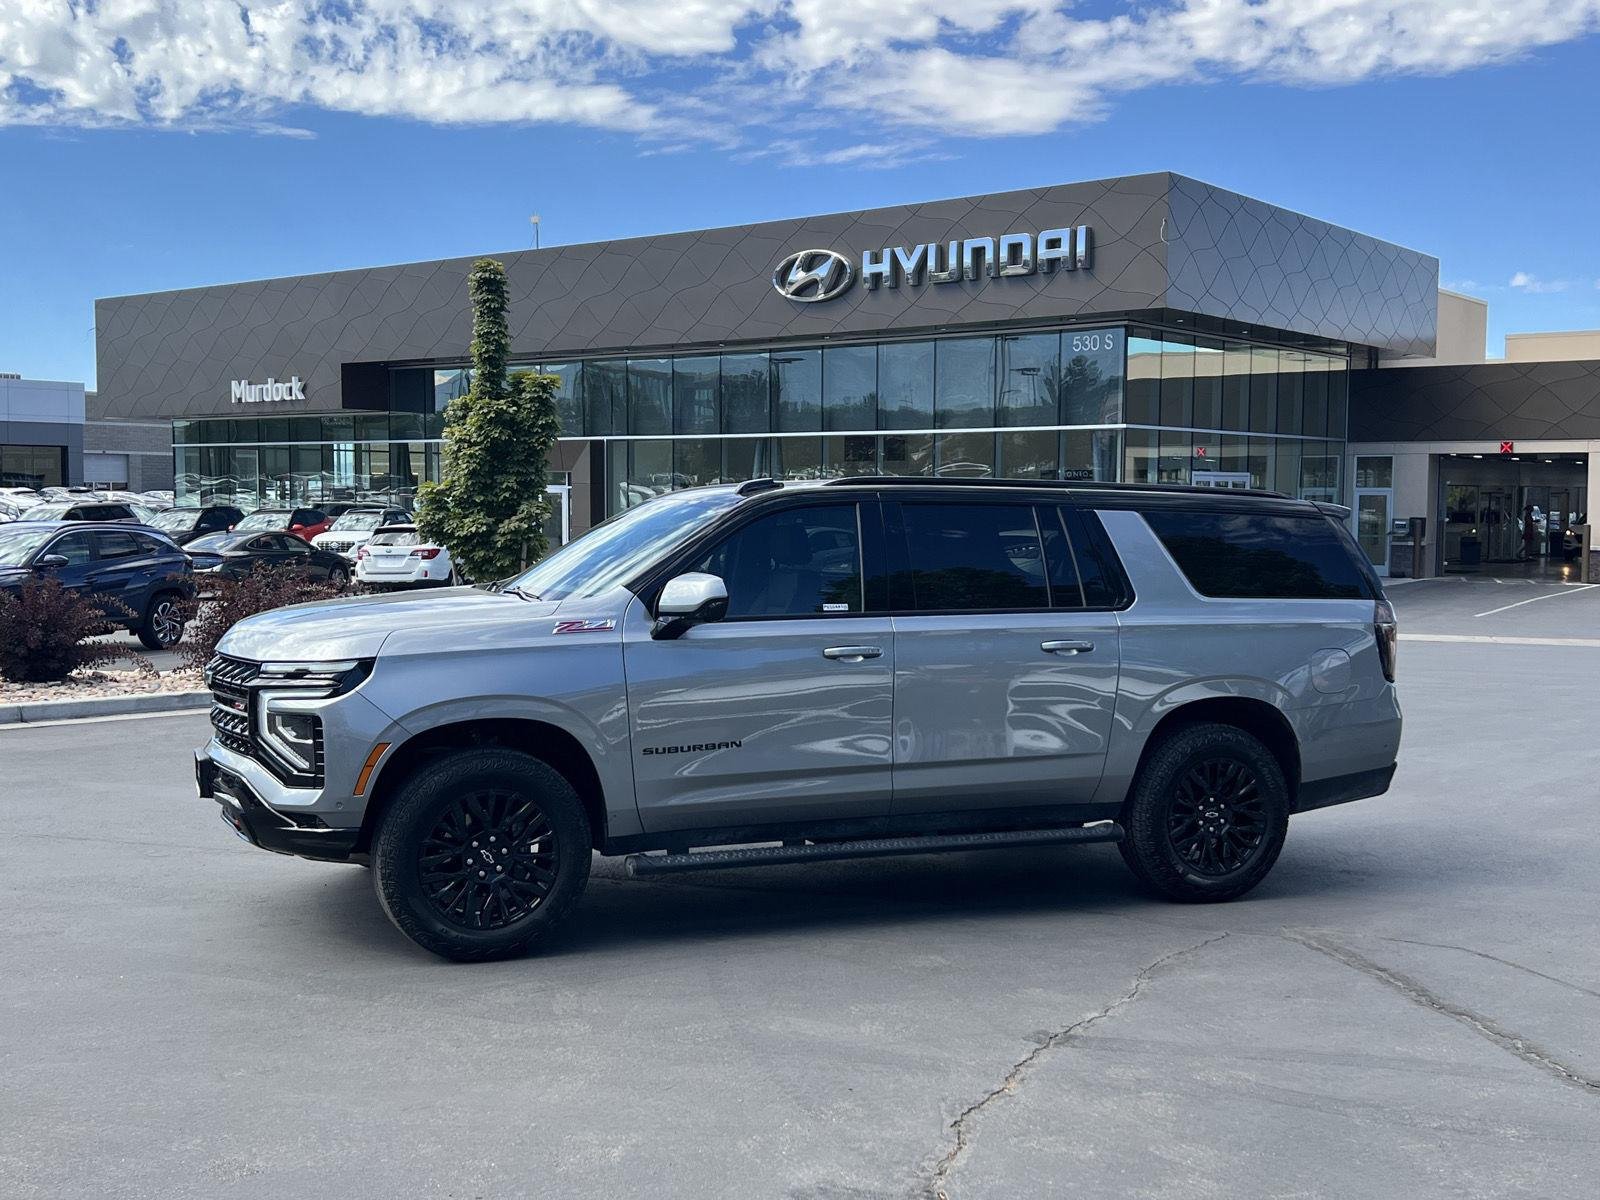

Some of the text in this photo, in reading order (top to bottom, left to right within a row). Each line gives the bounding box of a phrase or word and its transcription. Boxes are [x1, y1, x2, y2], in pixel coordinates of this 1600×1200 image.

[863, 225, 1092, 290] HYUNDAI
[1072, 333, 1114, 352] 530 S
[231, 376, 306, 403] Murdock
[642, 740, 742, 755] SUBURBAN
